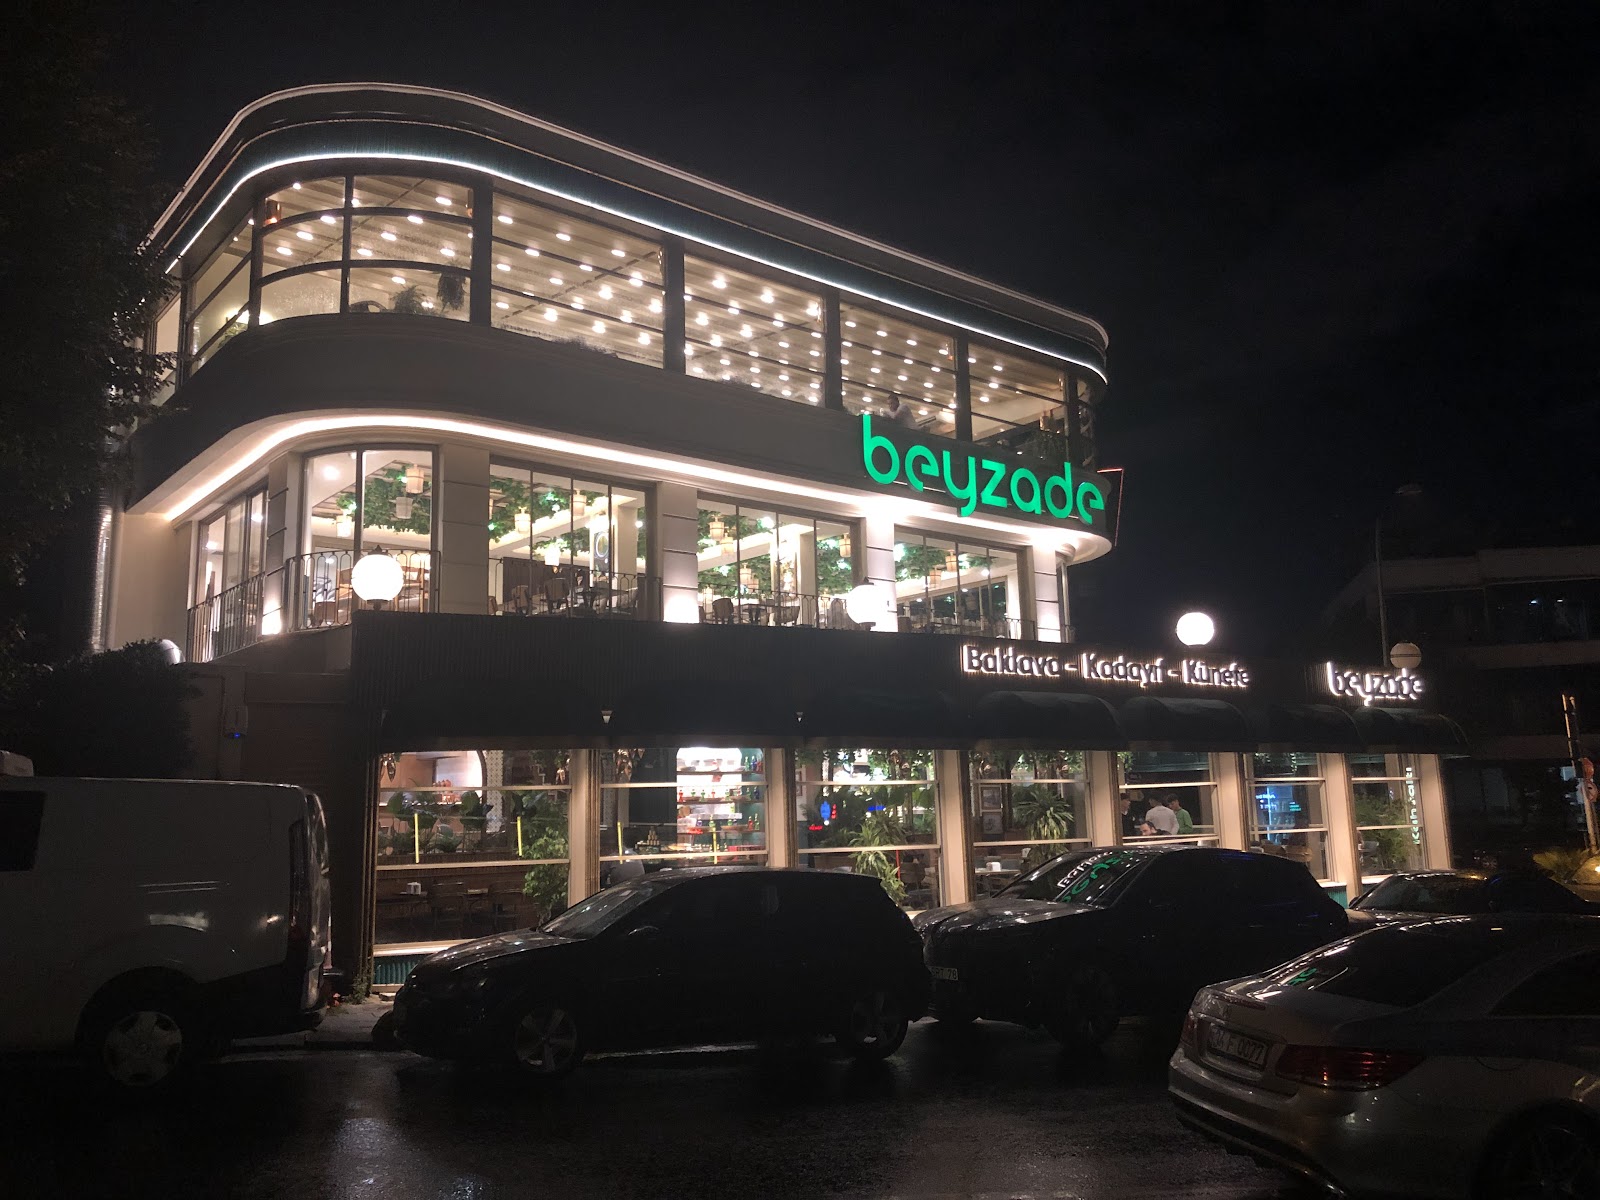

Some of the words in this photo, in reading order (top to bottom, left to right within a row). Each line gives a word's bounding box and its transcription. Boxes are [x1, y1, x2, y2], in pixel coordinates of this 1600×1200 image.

[862, 413, 1105, 525] beyzade
[962, 644, 1060, 677] Baklava
[1326, 661, 1423, 707] beyzade
